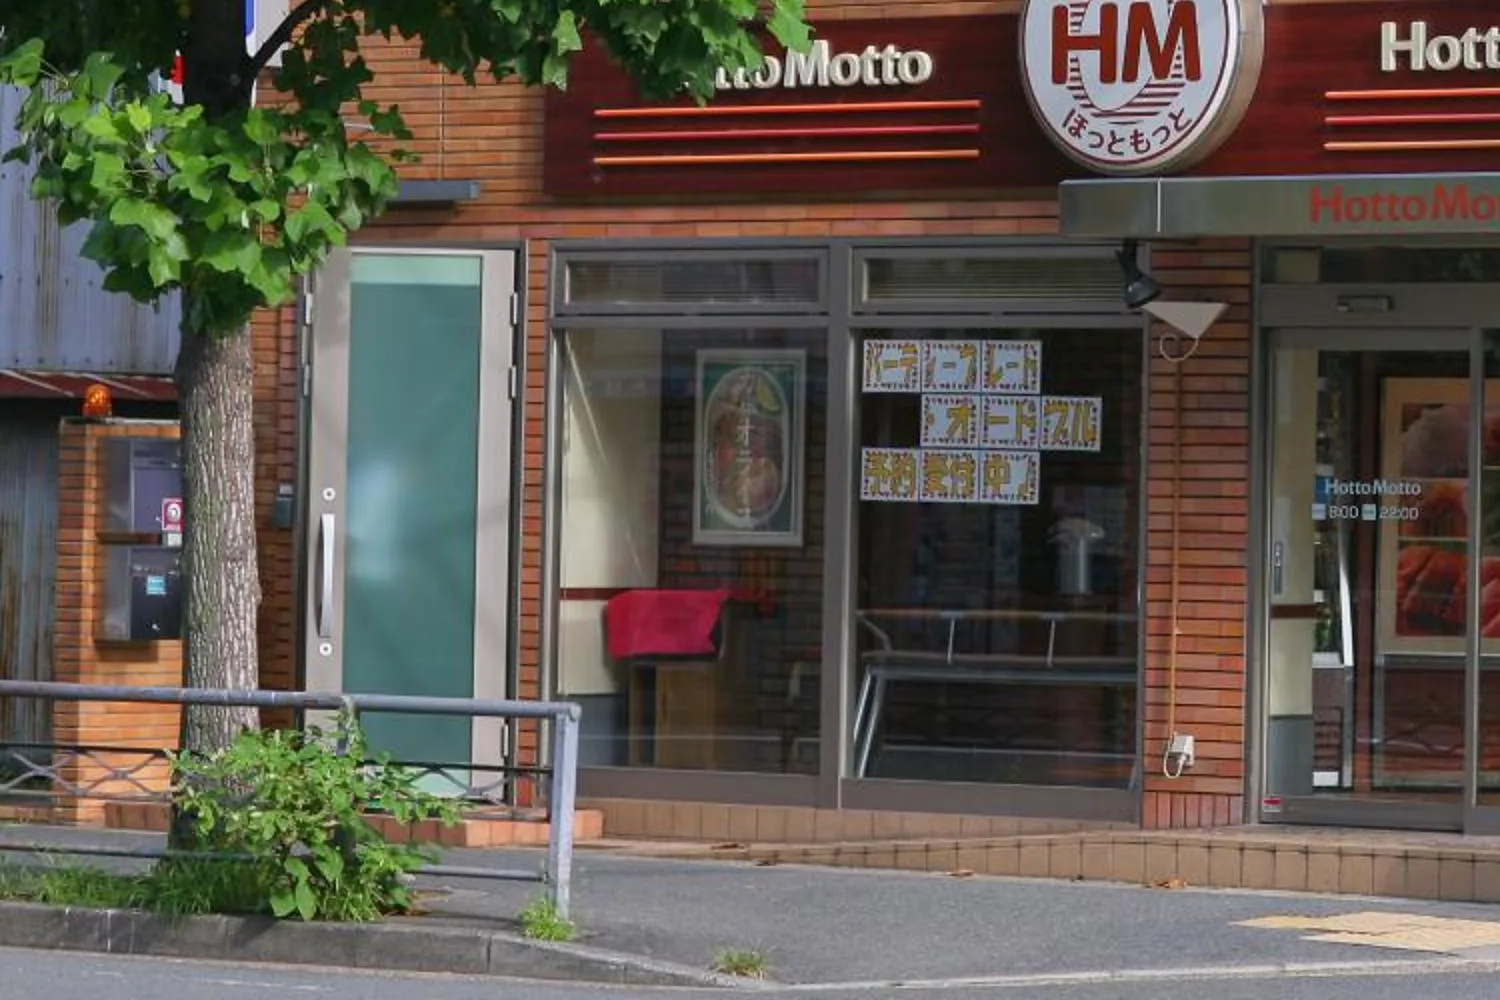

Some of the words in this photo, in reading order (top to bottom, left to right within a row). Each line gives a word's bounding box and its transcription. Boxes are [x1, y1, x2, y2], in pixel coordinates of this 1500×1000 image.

[1052, 0, 1201, 84] HM
[1062, 107, 1193, 156] ほっともっと
[1324, 479, 1422, 495] HottoMotto
